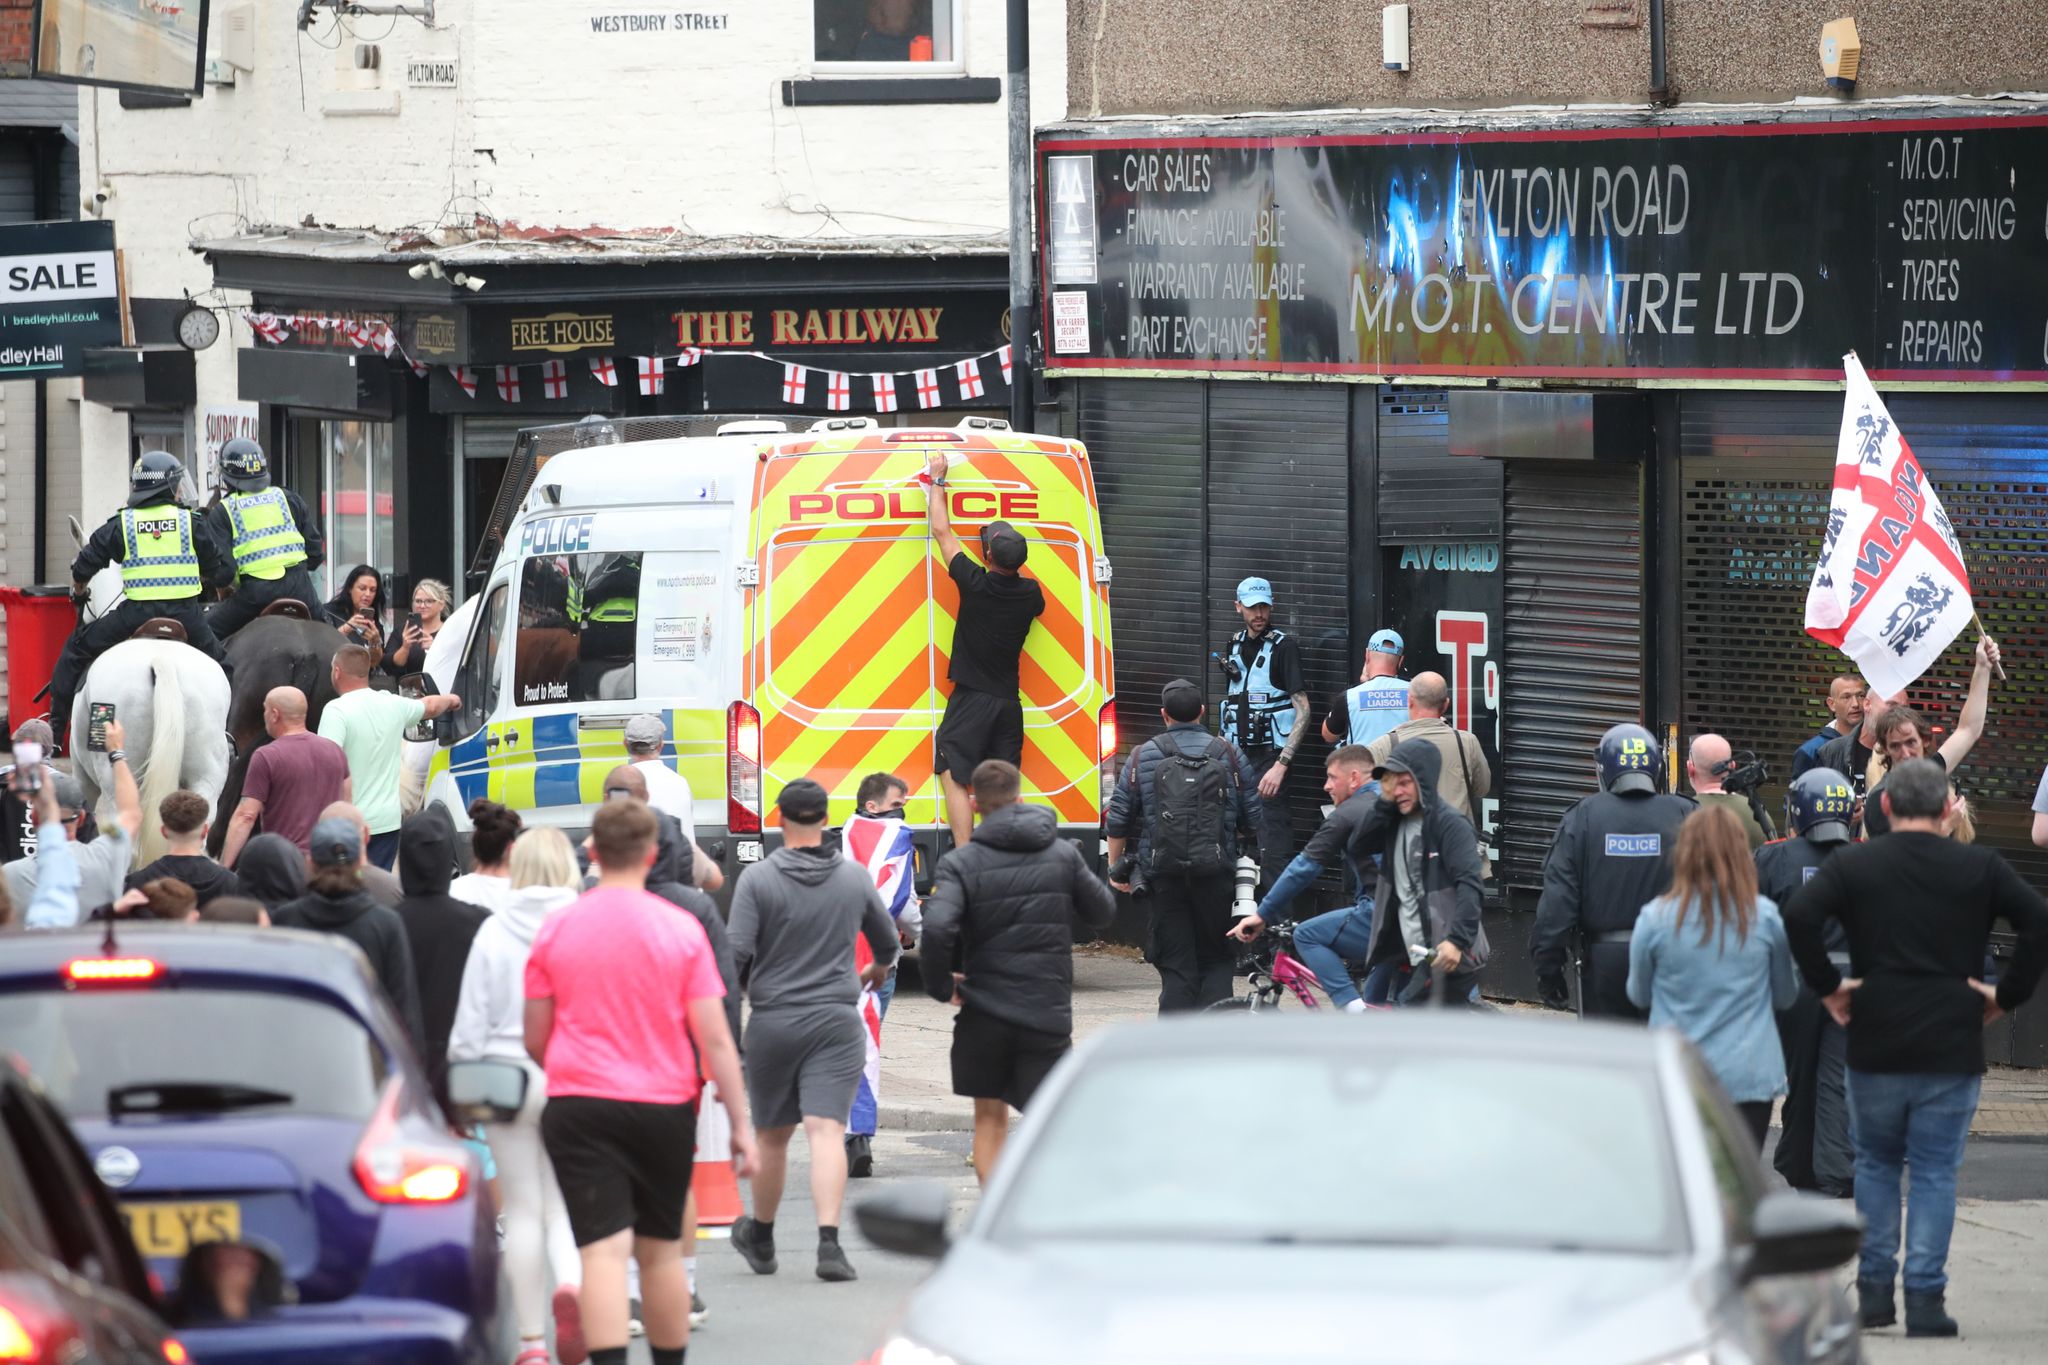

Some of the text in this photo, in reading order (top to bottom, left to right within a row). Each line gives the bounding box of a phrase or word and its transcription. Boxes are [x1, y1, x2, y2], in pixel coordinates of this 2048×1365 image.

[591, 13, 729, 32] WESTBURY STREET
[408, 64, 454, 83] HYLTON ROAD
[1900, 137, 1963, 180] M.O.T
[1124, 154, 1211, 192] CAR SALES
[1459, 164, 1689, 238] HYLTON ROAD
[1127, 209, 1286, 247] FINANCE AVAILABLE
[1901, 197, 2016, 241] SERVICING
[9, 263, 97, 291] SALE
[1129, 262, 1305, 301] WARRANTY AVAILABLE
[1902, 259, 1960, 302] TYRES
[1350, 272, 1804, 335] M.O.T. CENTRE LTD
[13, 311, 99, 326] bradleyhall.co.uk
[511, 319, 615, 346] FREE HOUSE
[672, 308, 943, 347] THE RAILWAY
[1131, 316, 1267, 354] PART EXCHANGE
[1899, 320, 1983, 363] REPAIRS
[205, 413, 238, 443] SUNDAY
[246, 460, 261, 472] LB
[239, 494, 274, 508] POLICE
[788, 491, 1040, 522] POLCE
[138, 519, 176, 533] POLICE
[520, 516, 594, 556] POLICE
[654, 644, 681, 657] Emergency
[523, 681, 568, 701] Proud to Protect
[1367, 691, 1401, 699] POLICE
[1367, 699, 1403, 707] LIAISON
[1623, 738, 1647, 754] LB
[1825, 784, 1848, 798] LB
[1608, 838, 1658, 851] POLICE
